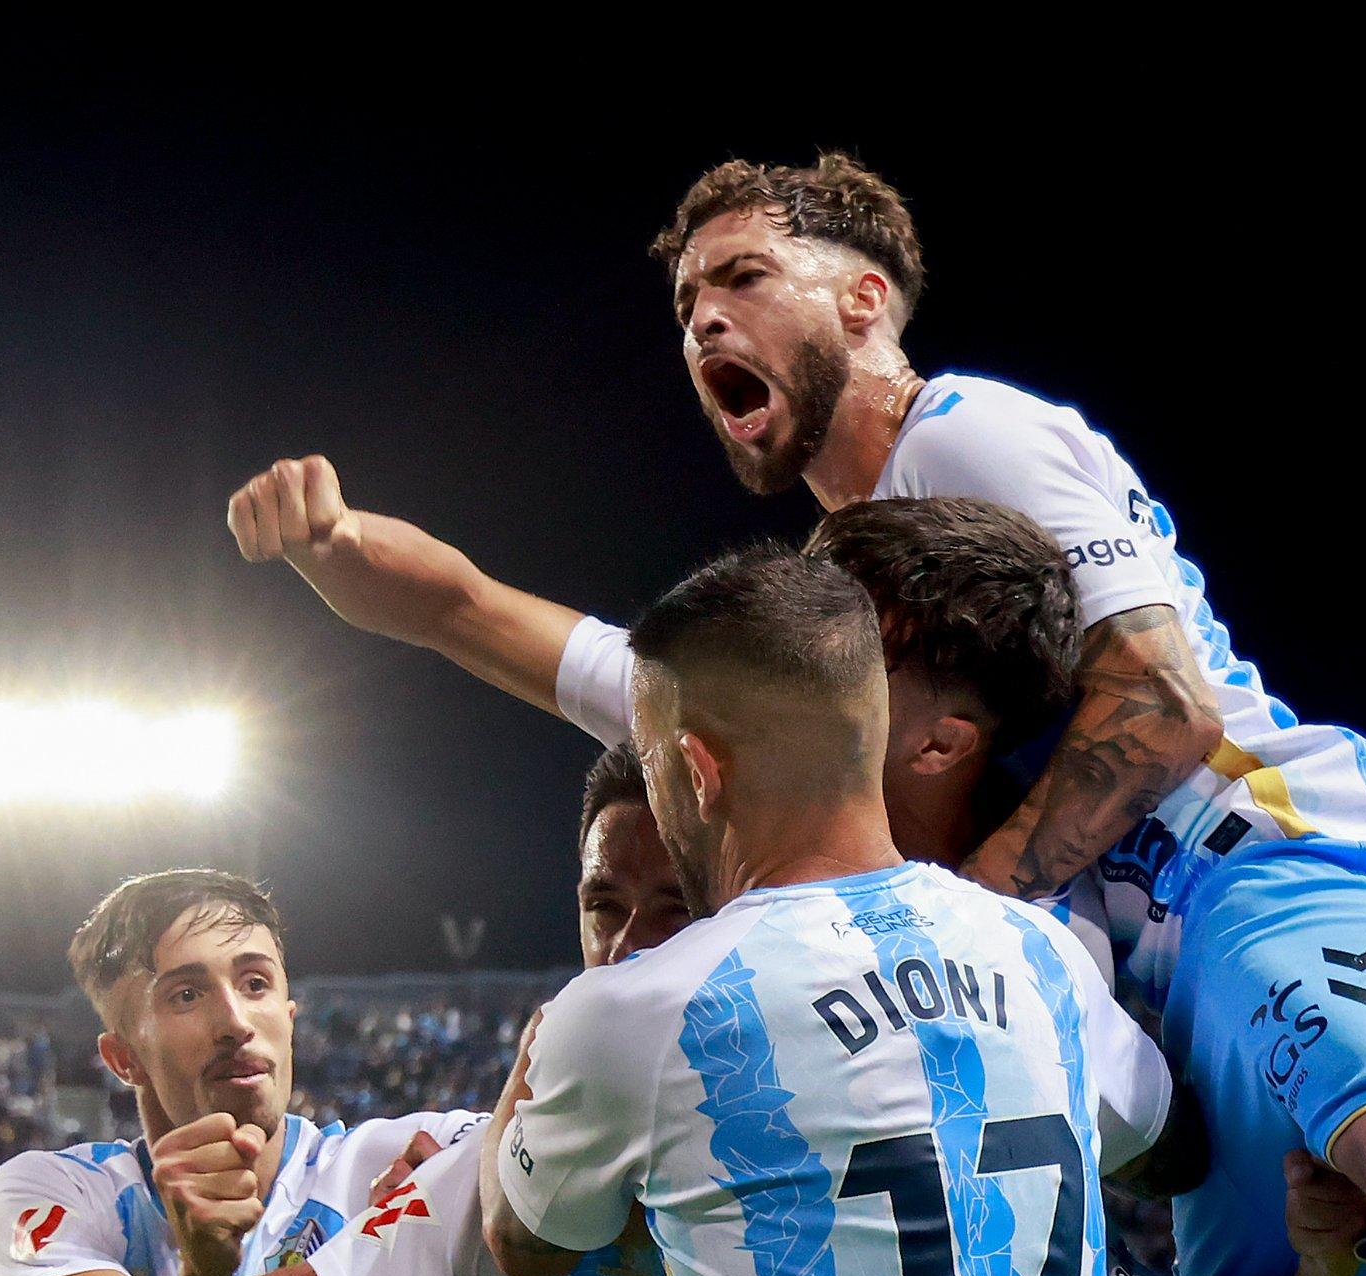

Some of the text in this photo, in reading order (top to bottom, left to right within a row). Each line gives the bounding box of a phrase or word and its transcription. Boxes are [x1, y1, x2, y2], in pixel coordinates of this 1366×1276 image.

[853, 908, 927, 928] DENTAL
[861, 918, 935, 936] CLINICS
[812, 957, 1009, 1056] DIONI
